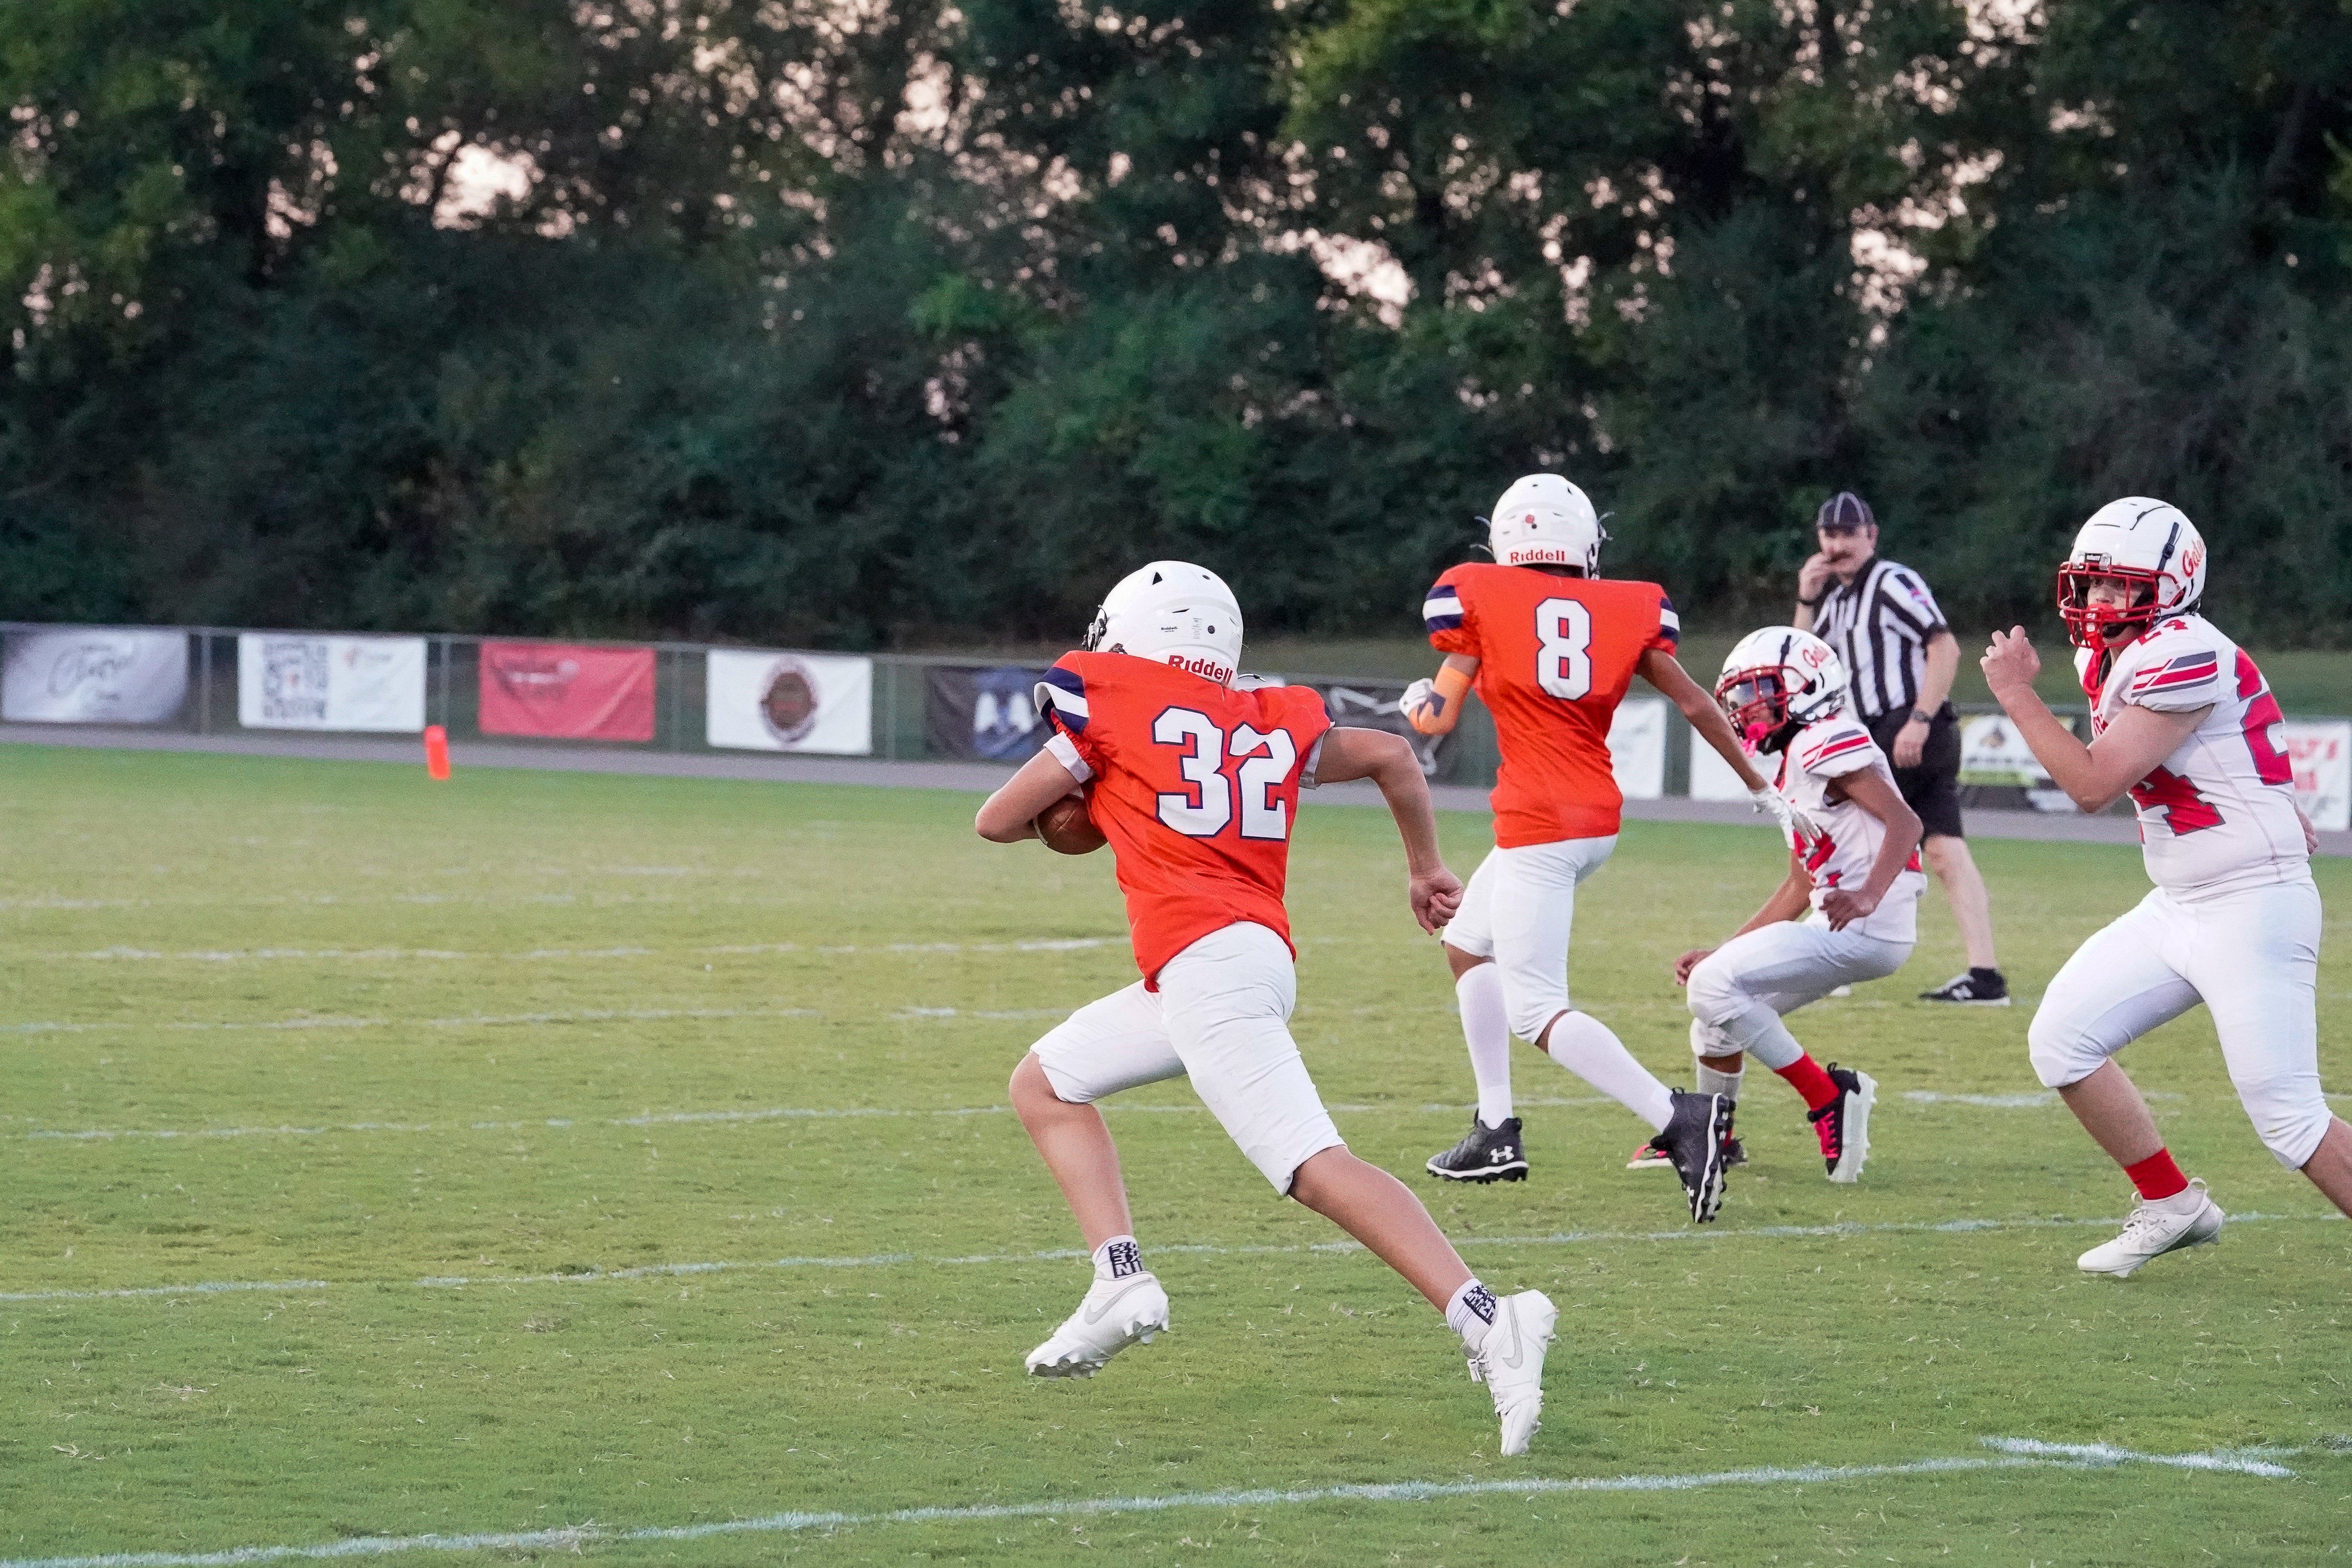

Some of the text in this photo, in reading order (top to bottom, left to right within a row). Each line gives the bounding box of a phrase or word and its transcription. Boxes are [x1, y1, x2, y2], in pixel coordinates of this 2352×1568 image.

[1510, 549, 1566, 563] Riddell
[1168, 655, 1233, 686] Riddell
[1535, 597, 1591, 701] 8
[1151, 705, 1297, 842] 32
